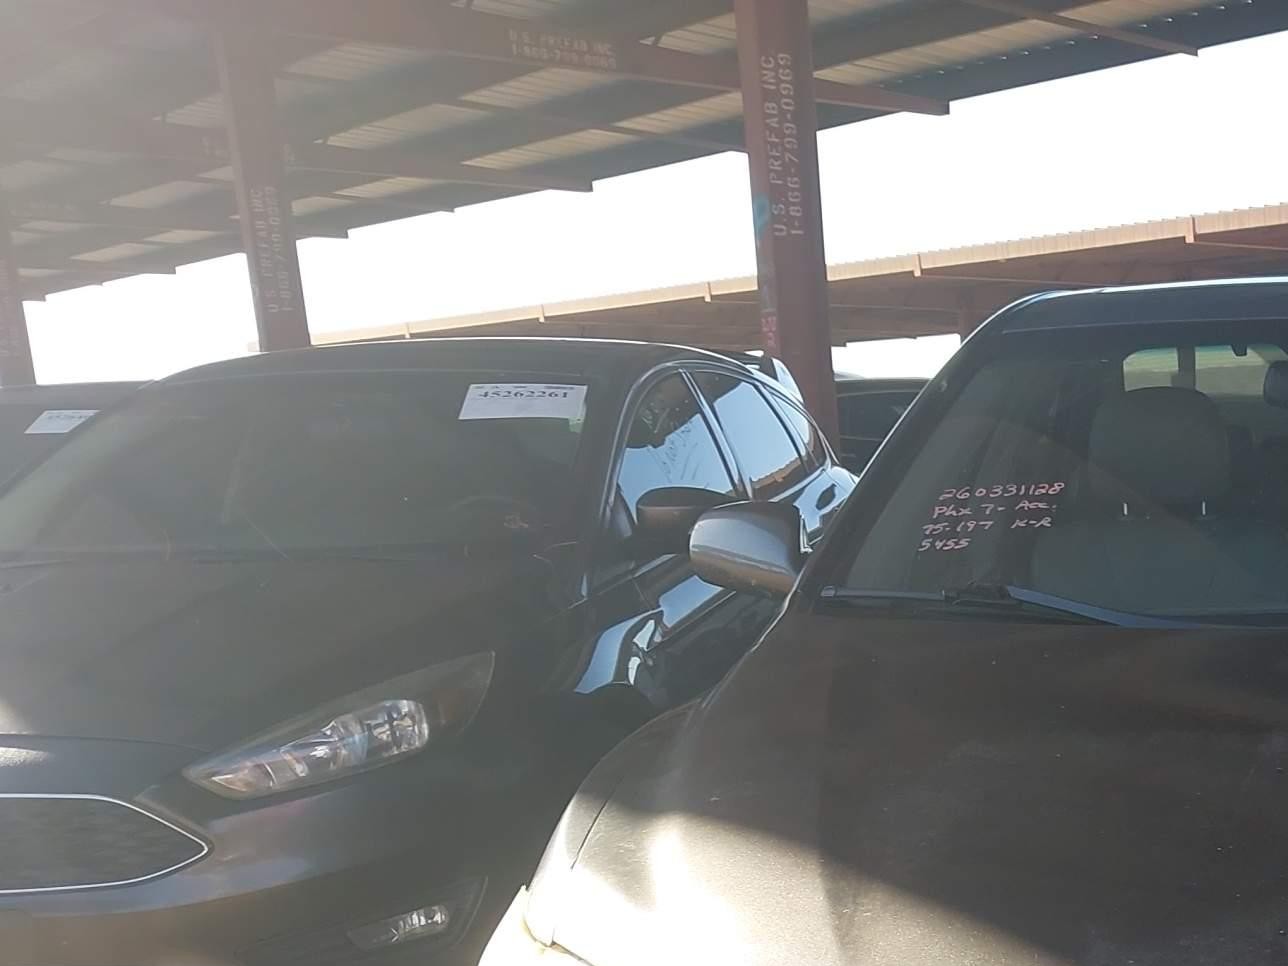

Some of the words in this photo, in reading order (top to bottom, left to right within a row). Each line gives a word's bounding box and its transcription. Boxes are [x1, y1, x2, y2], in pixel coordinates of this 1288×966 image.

[760, 55, 777, 90] INC
[764, 101, 784, 185] PREFAB
[777, 53, 804, 236] 1-866-799-0969
[478, 390, 568, 399] 45262261
[939, 482, 1065, 501] 260331128
